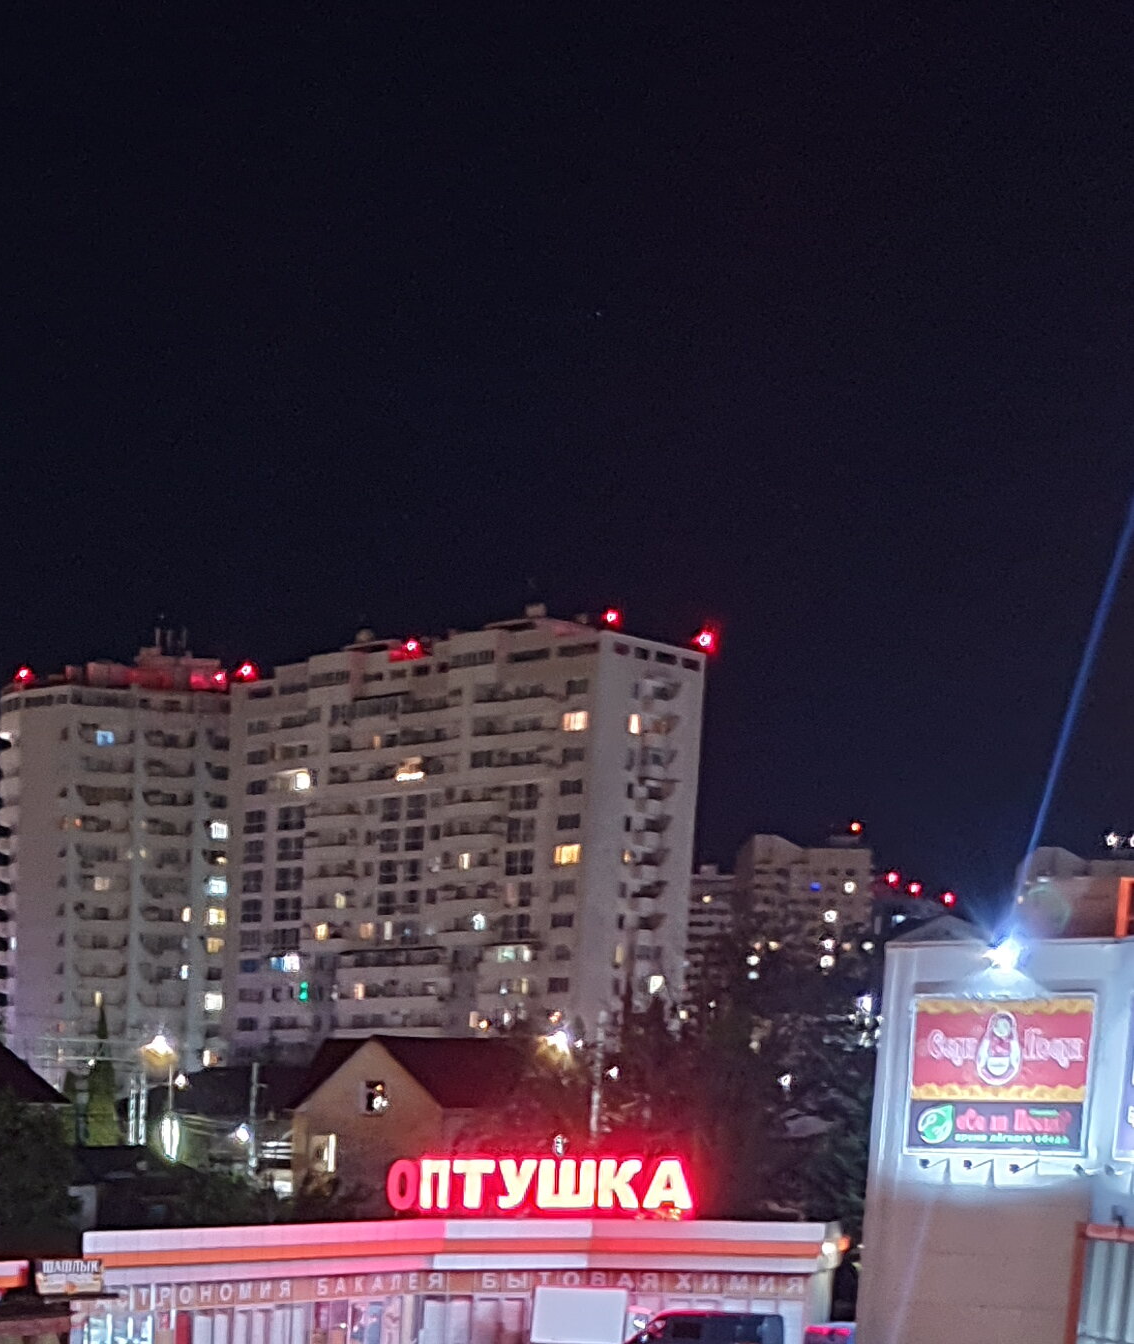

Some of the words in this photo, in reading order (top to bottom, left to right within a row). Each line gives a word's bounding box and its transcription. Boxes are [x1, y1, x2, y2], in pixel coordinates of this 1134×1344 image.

[387, 1159, 693, 1211] ОПТУШКА
[42, 1260, 99, 1274] ШАШЛЫК
[317, 1273, 444, 1296] БАКАЛЕЯ
[481, 1271, 659, 1292] БЫТОВАЯ
[675, 1273, 805, 1294] ХИМИЯ
